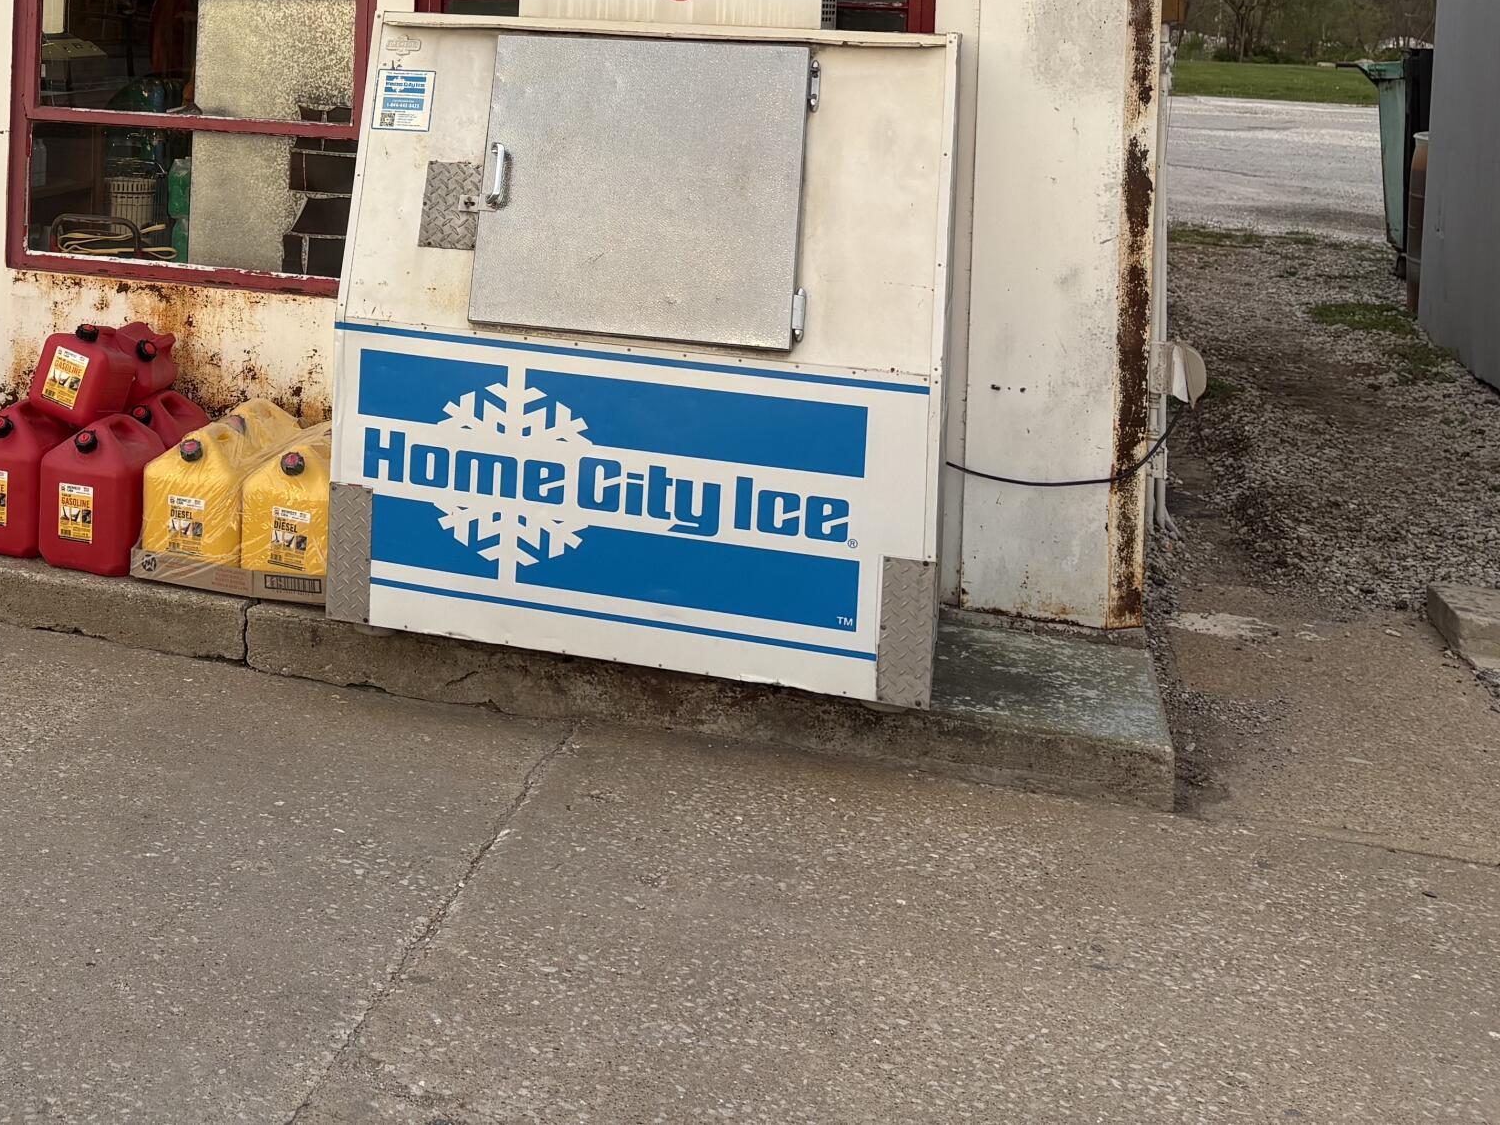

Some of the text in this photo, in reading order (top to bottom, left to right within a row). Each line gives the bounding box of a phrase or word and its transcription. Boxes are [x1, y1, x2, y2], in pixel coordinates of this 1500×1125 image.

[54, 359, 82, 376] GASOLINE
[363, 427, 850, 543] Home City Ice
[61, 496, 90, 509] GASOLINE
[170, 508, 194, 520] DIESEL
[273, 520, 298, 534] DIESEL
[836, 615, 854, 627] TM
